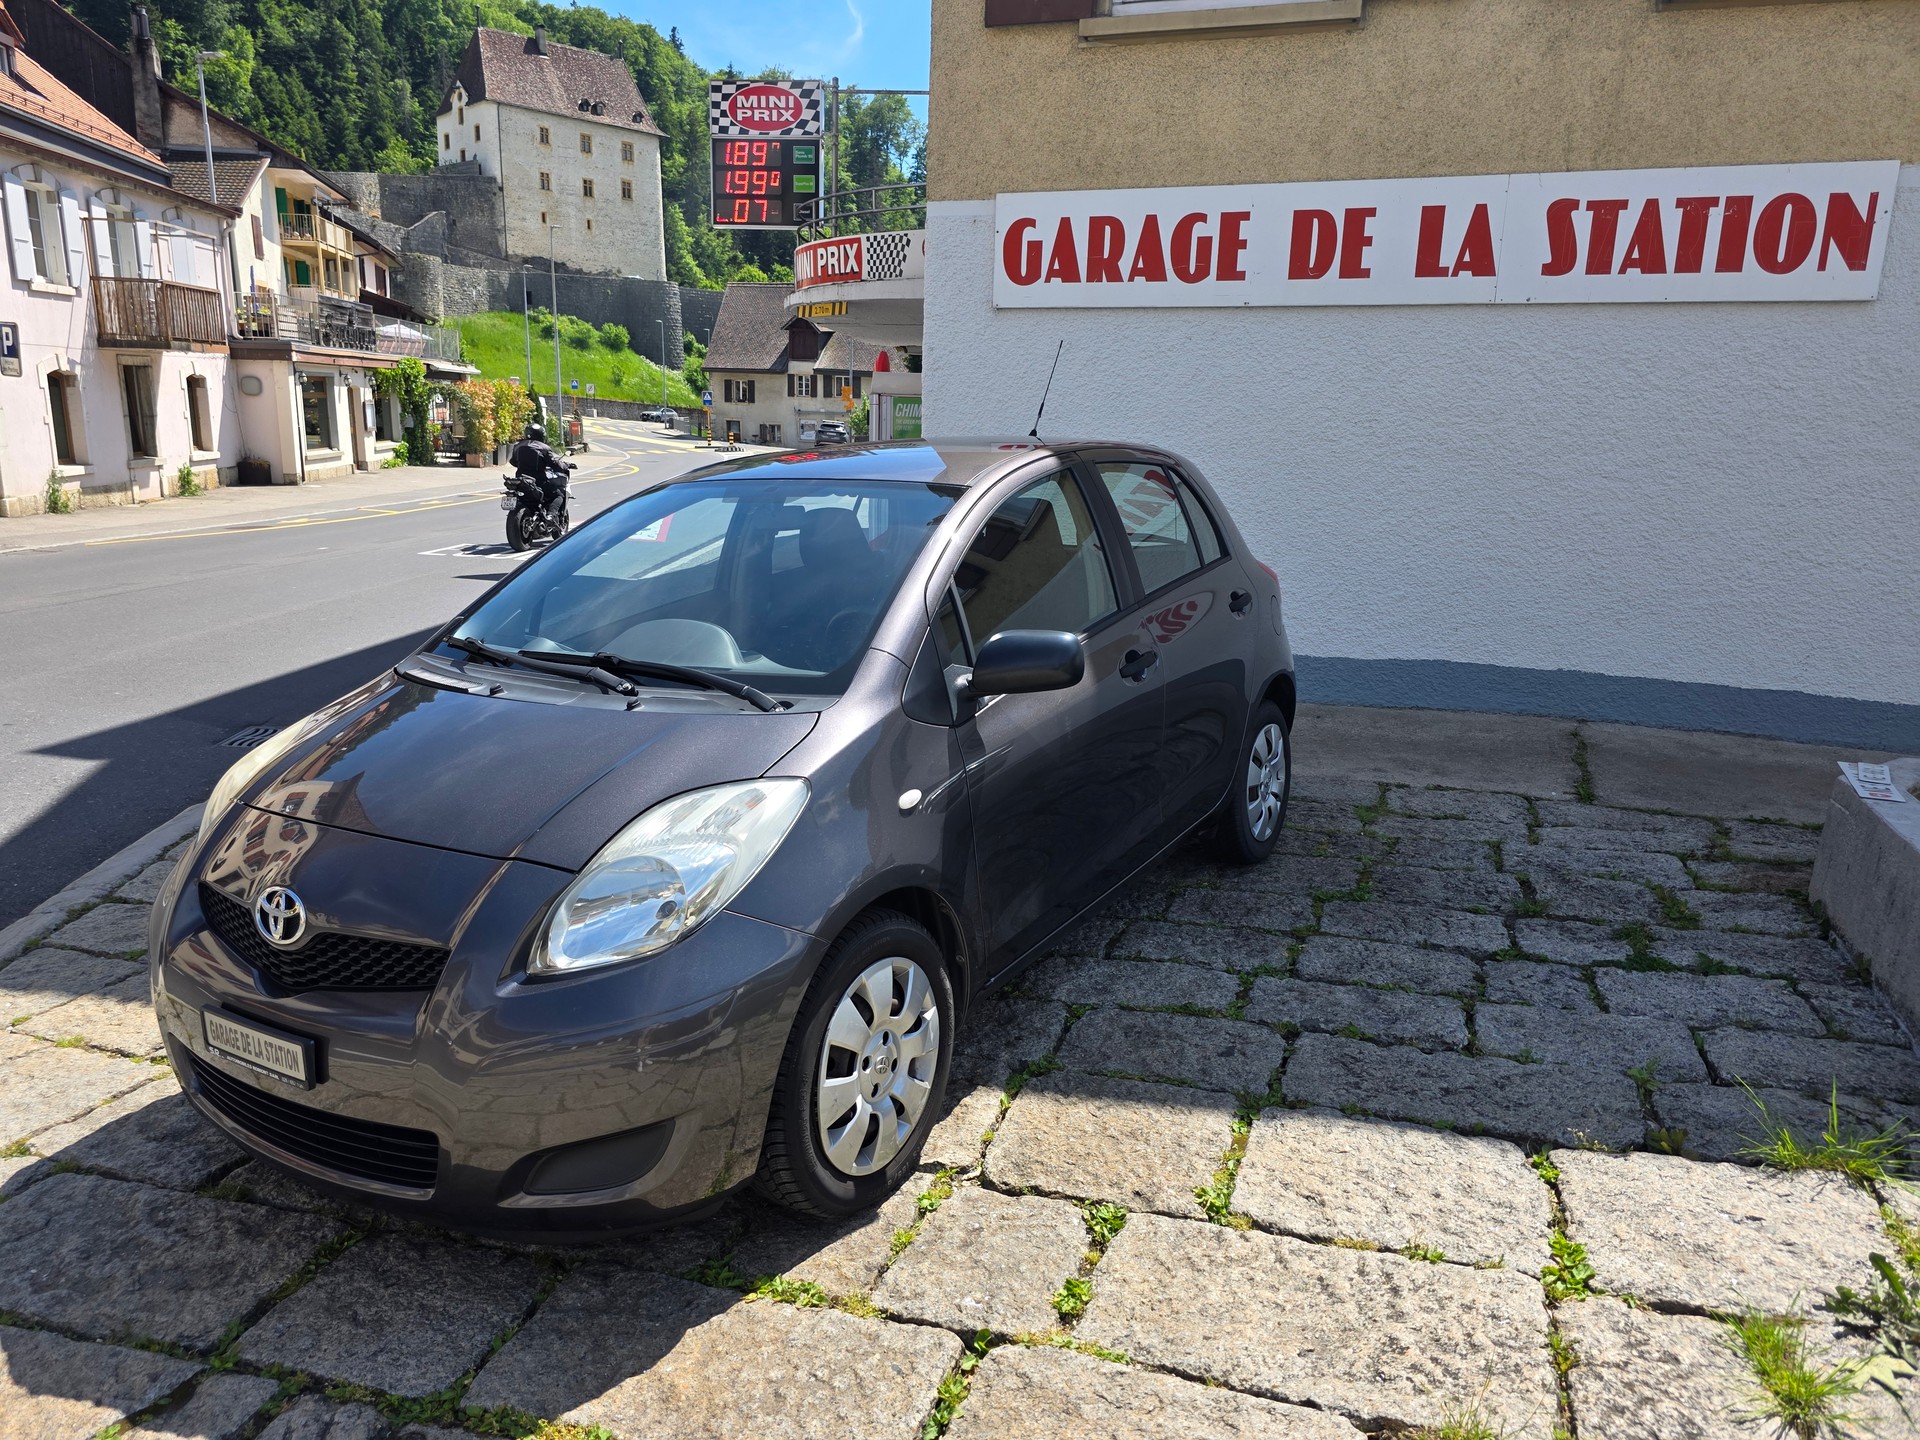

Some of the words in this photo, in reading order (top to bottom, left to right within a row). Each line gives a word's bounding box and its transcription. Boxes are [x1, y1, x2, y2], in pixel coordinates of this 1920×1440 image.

[736, 95, 795, 109] MINI
[736, 109, 795, 122] PRIX
[1003, 210, 1251, 287] GARAGE
[1289, 207, 1377, 279] DE
[1415, 204, 1496, 278] LA
[1541, 191, 1879, 276] STATION
[817, 242, 861, 278] PRIX
[2, 326, 13, 355] P
[209, 1019, 241, 1051] GARAGE
[240, 1031, 253, 1056] DE
[252, 1036, 264, 1060] LA
[264, 1040, 300, 1073] STATION
